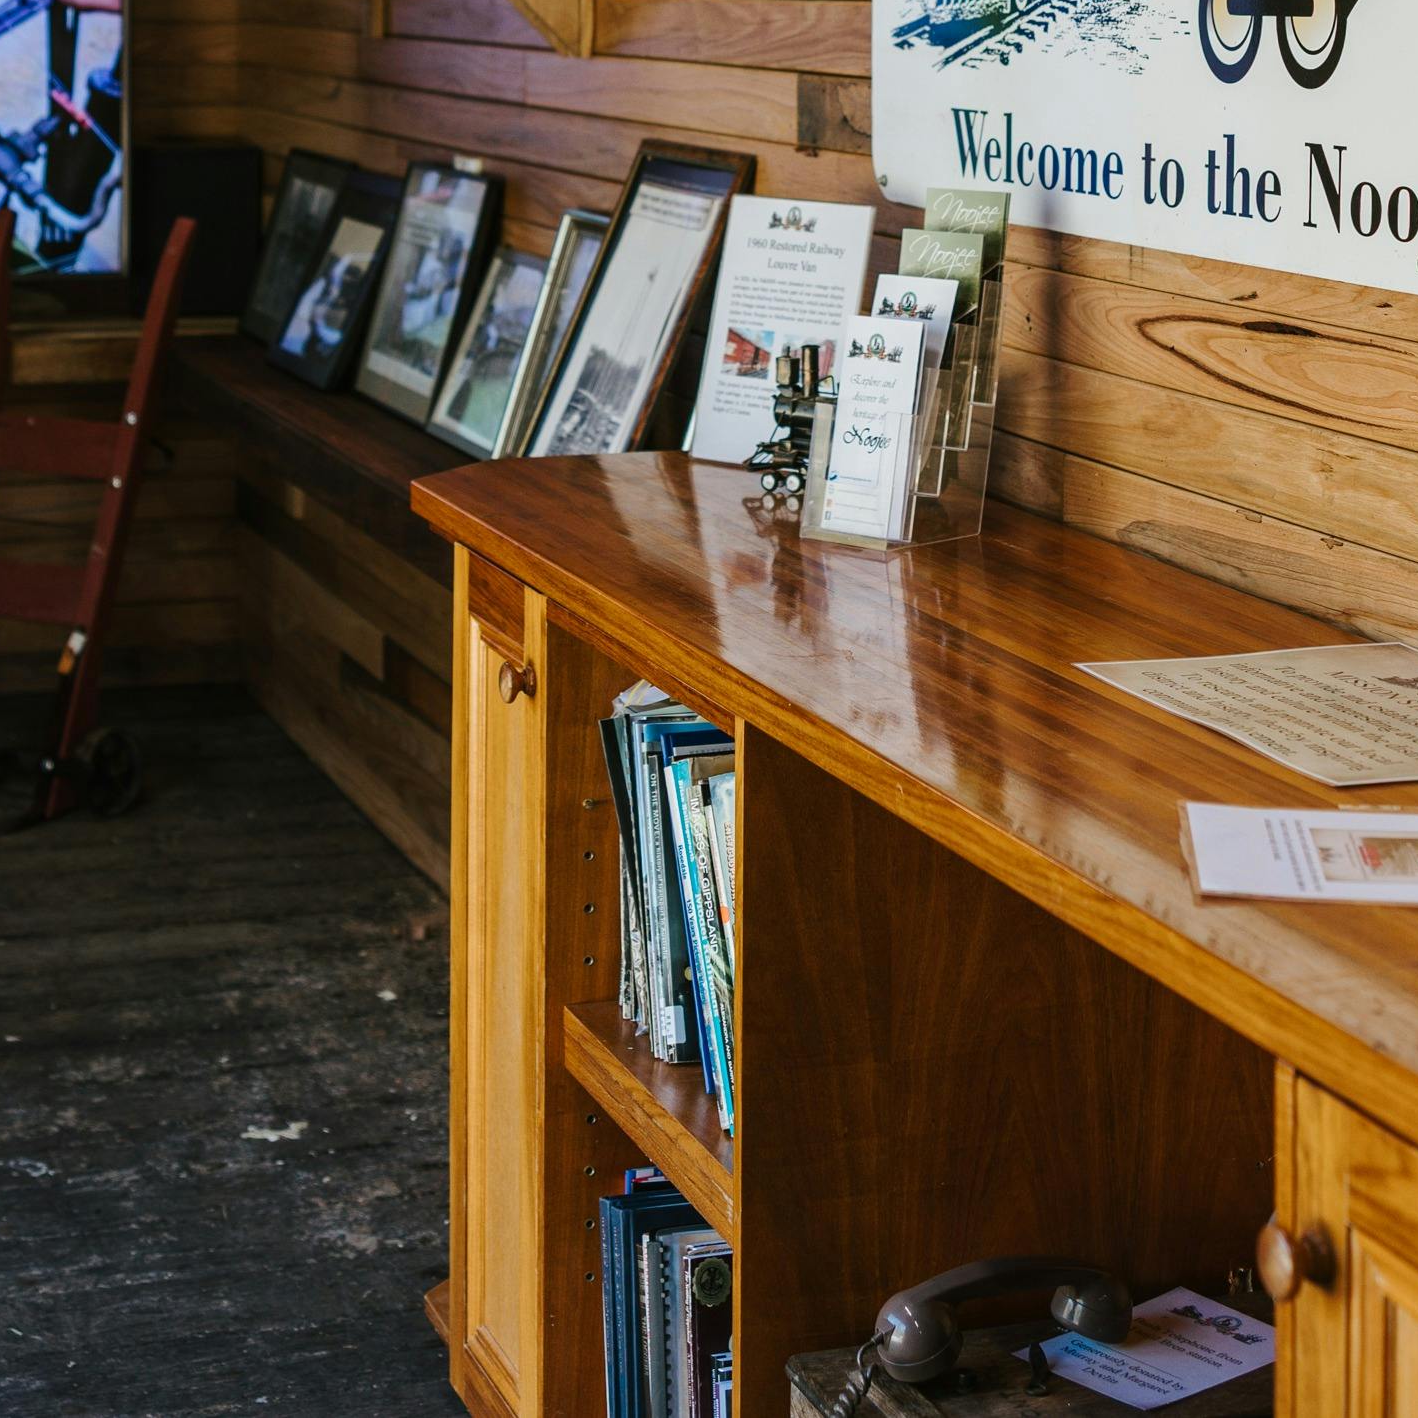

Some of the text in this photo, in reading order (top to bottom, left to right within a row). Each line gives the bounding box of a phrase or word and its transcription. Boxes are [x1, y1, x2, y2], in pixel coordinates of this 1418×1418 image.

[950, 106, 1125, 201] Welcome
[1140, 141, 1185, 209] to
[1204, 132, 1283, 225] the
[933, 192, 1001, 234] Noojee
[769, 238, 806, 254] Restored
[809, 242, 846, 259] Railway
[909, 235, 979, 279] Noojee
[767, 258, 817, 273] Louvre Van
[842, 424, 893, 454] Noojee
[1330, 670, 1399, 699] MISSION
[649, 773, 657, 788] ON
[650, 789, 659, 808] THE
[689, 797, 709, 851] IMAGES
[677, 844, 688, 880] Rosedale
[697, 853, 712, 875] OF
[685, 898, 694, 915] 150
[700, 877, 719, 954] GIPPSLAND
[688, 917, 697, 938] Years
[724, 1044, 732, 1060] AND
[1060, 1345, 1169, 1394] Murray and Margaret
[1070, 1339, 1183, 1390] Generously donated by
[1185, 1350, 1222, 1368] station
